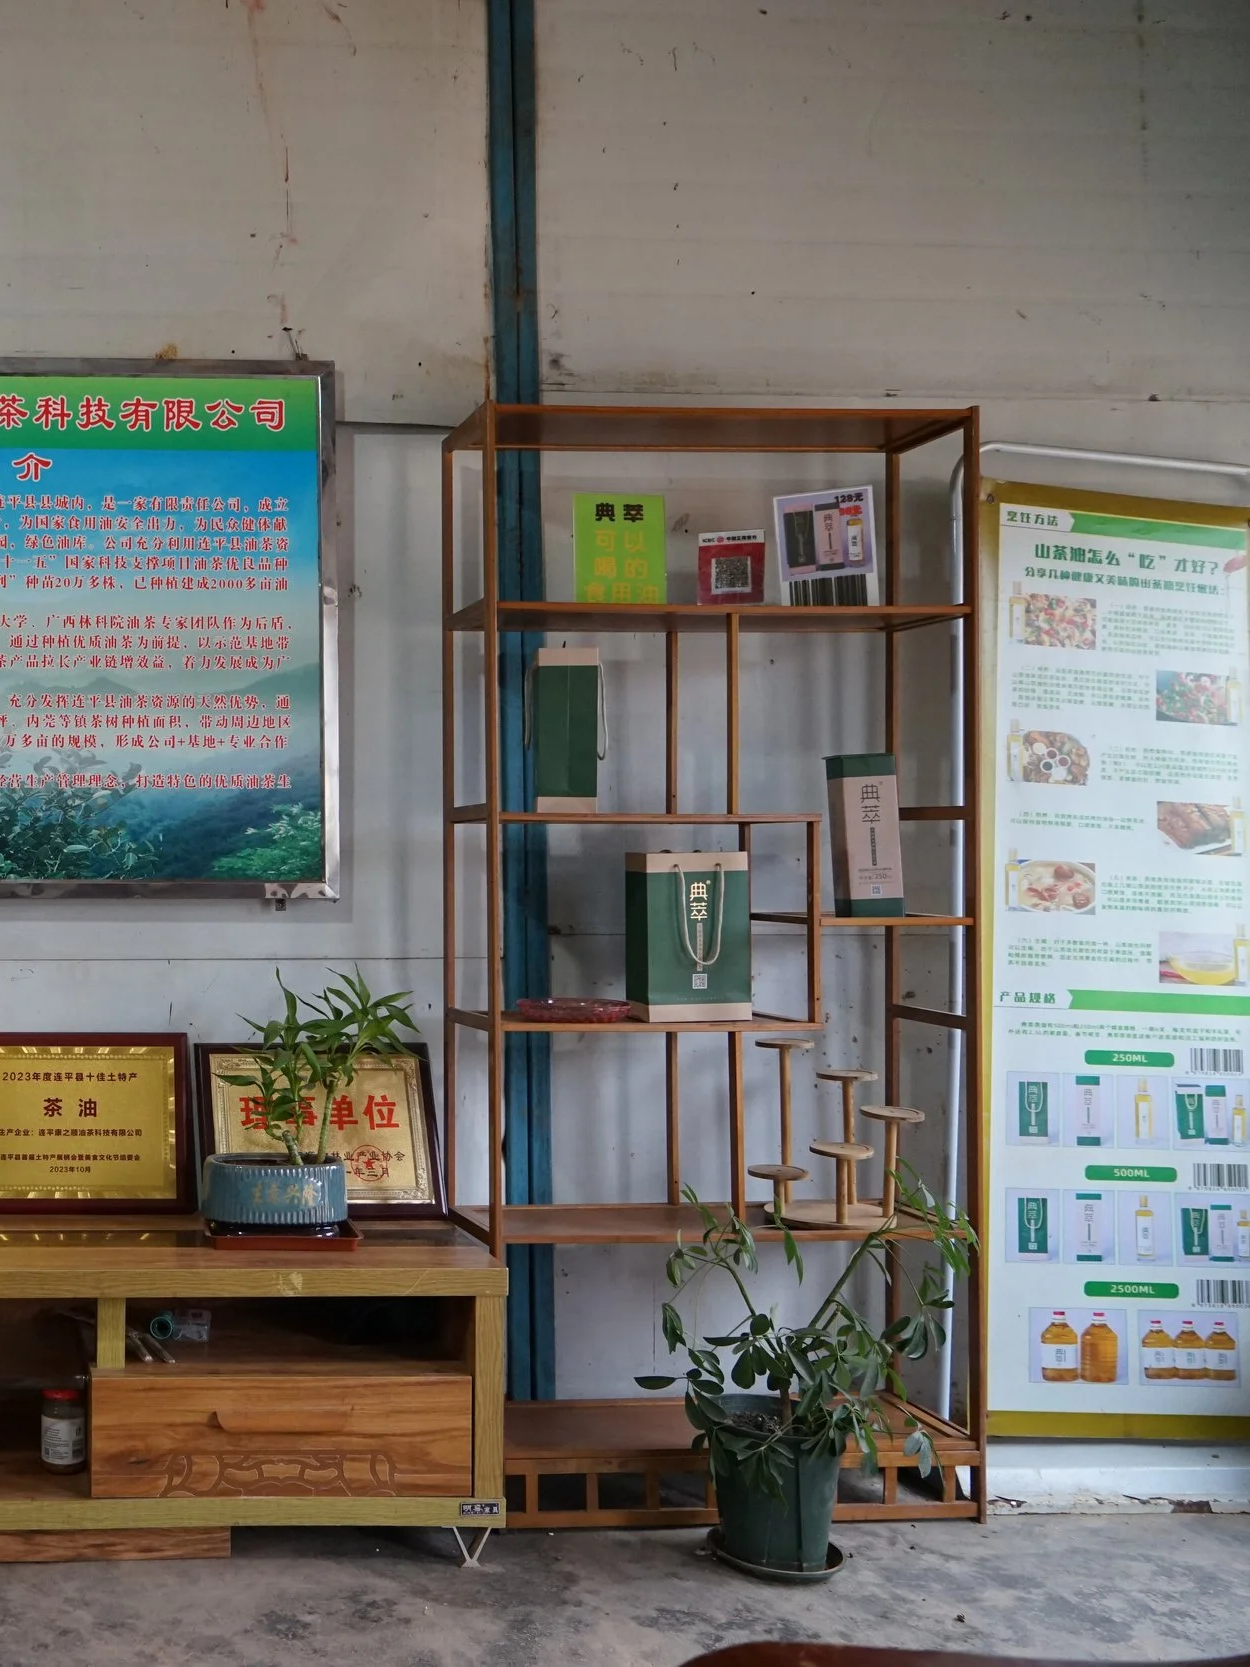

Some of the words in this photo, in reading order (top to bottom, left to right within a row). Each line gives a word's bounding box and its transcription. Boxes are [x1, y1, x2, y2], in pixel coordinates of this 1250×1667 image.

[595, 502, 644, 522] 典萃
[1006, 510, 1059, 527] 烹饪方法
[689, 881, 708, 921] 典萃
[999, 991, 1056, 1004] 产品规格
[1112, 1053, 1148, 1063] 250ML
[2, 1072, 138, 1082] 2023年度连平县十佳土特产
[1113, 1168, 1150, 1178] 500ML
[1110, 1284, 1156, 1295] 2500ML
